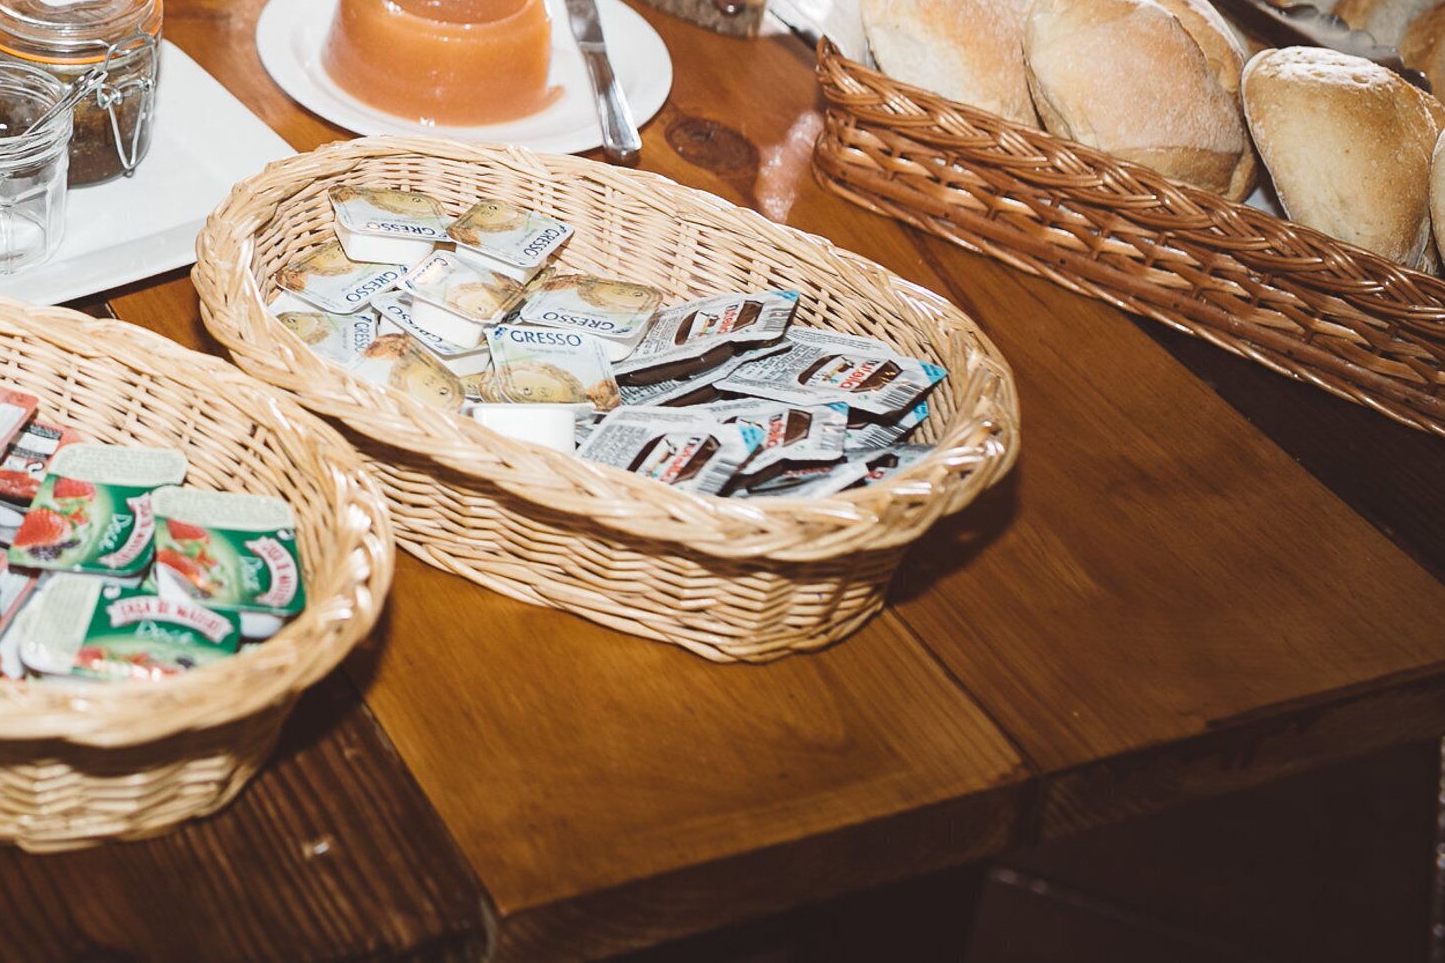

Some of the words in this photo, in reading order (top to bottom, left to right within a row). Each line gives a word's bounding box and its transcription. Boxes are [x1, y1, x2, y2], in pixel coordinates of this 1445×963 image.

[366, 221, 436, 237] GRESSO
[523, 227, 560, 257] GRESSO
[345, 270, 399, 304] GRESSO
[542, 311, 615, 333] GRESSO
[509, 329, 582, 347] GRESSO
